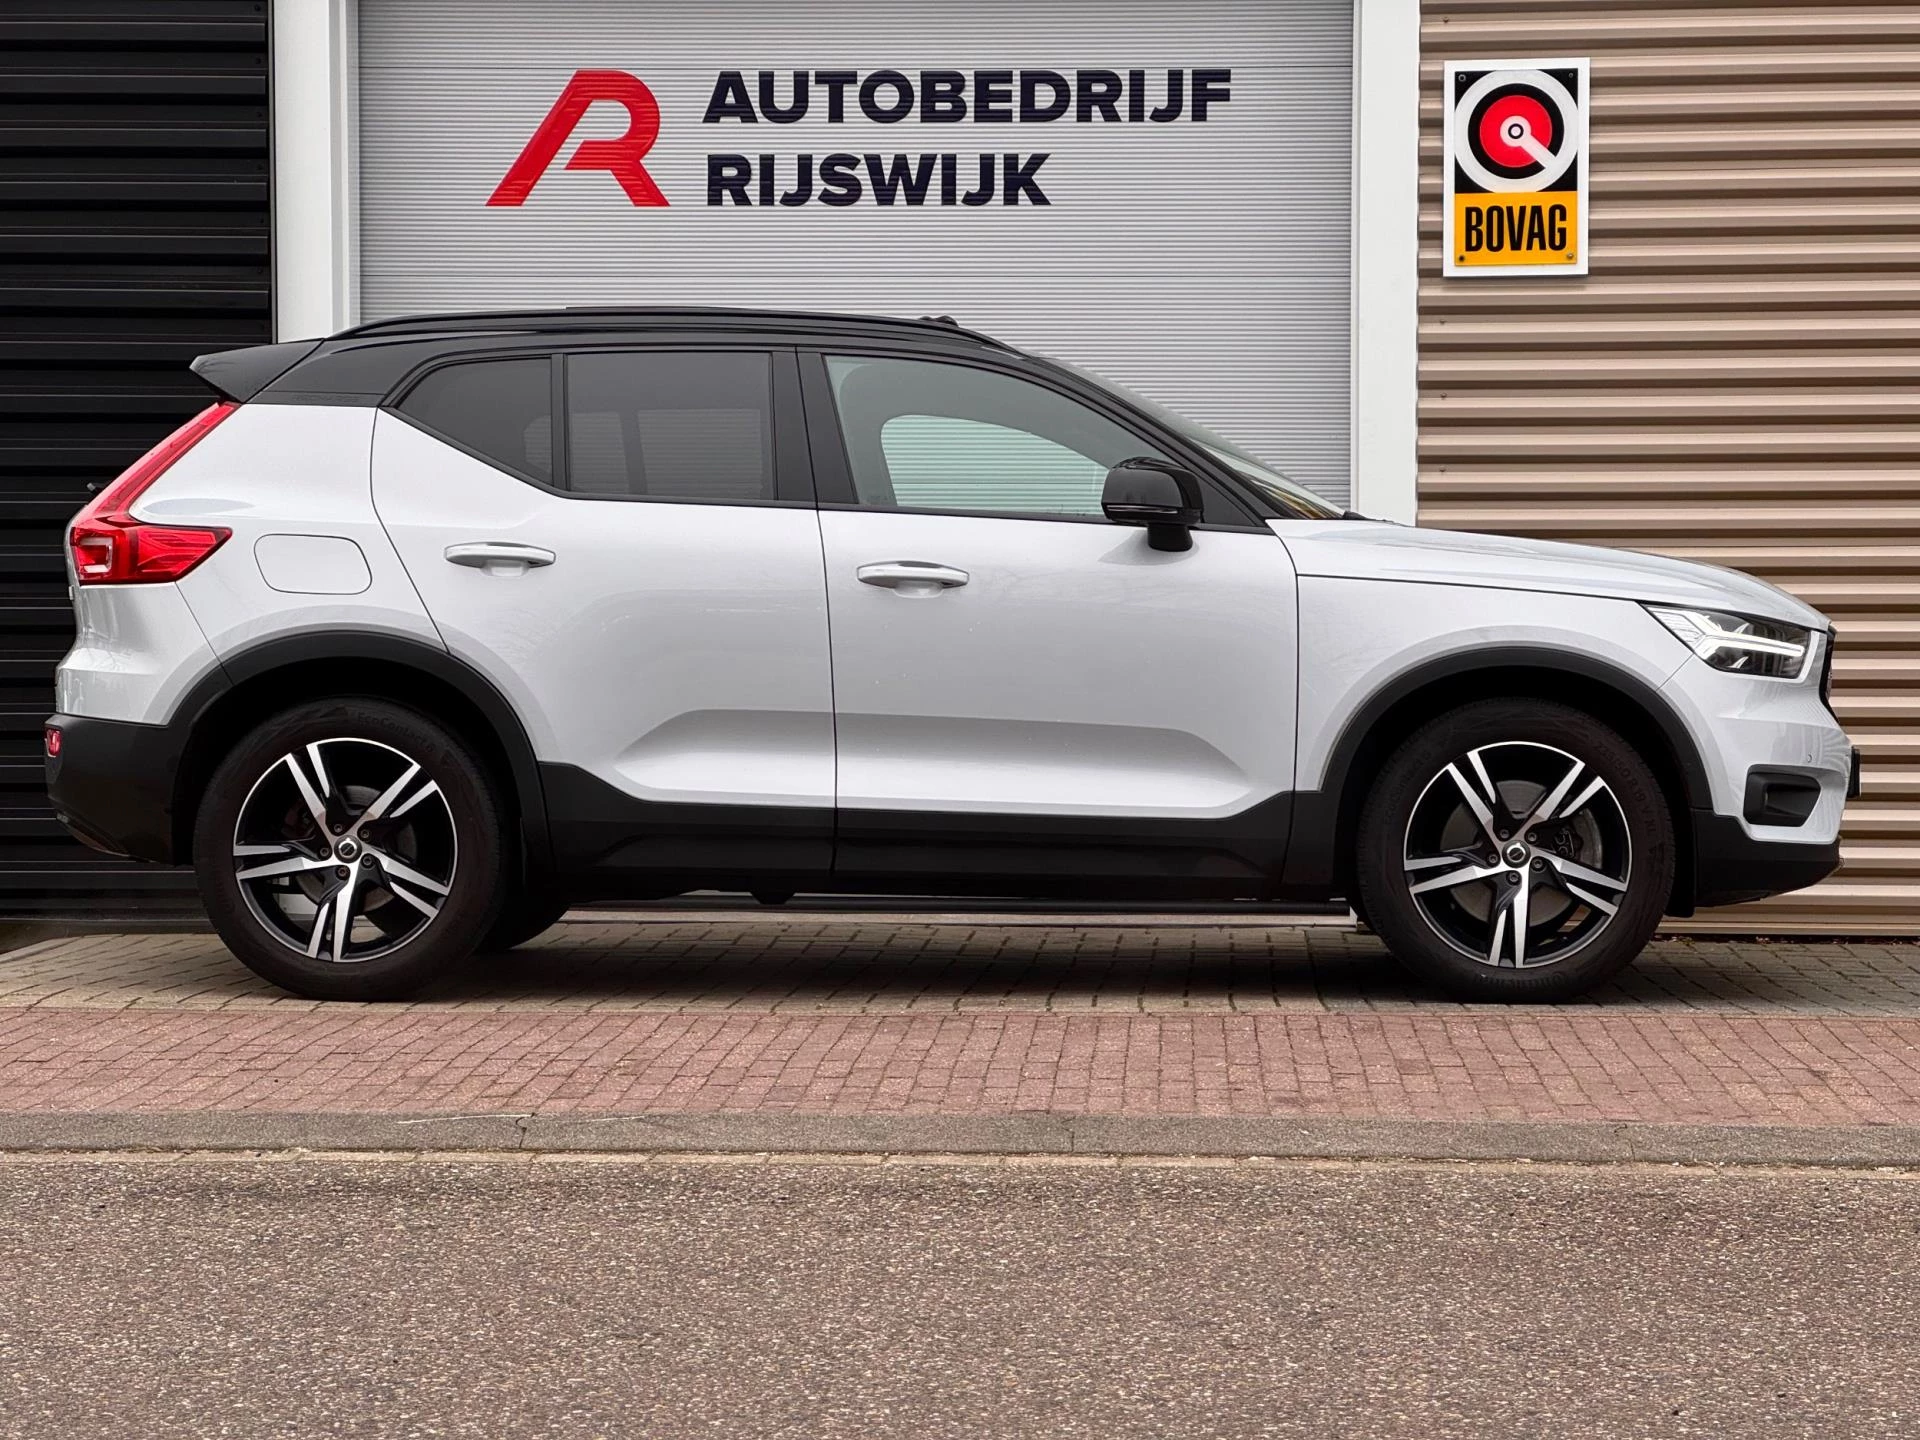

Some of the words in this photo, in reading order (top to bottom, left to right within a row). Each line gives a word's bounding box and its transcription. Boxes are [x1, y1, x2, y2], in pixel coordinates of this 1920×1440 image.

[703, 69, 1231, 123] AUTOBEDRIJF
[708, 154, 1050, 206] RIJSWIJK
[1465, 204, 1566, 252] BOVAG
